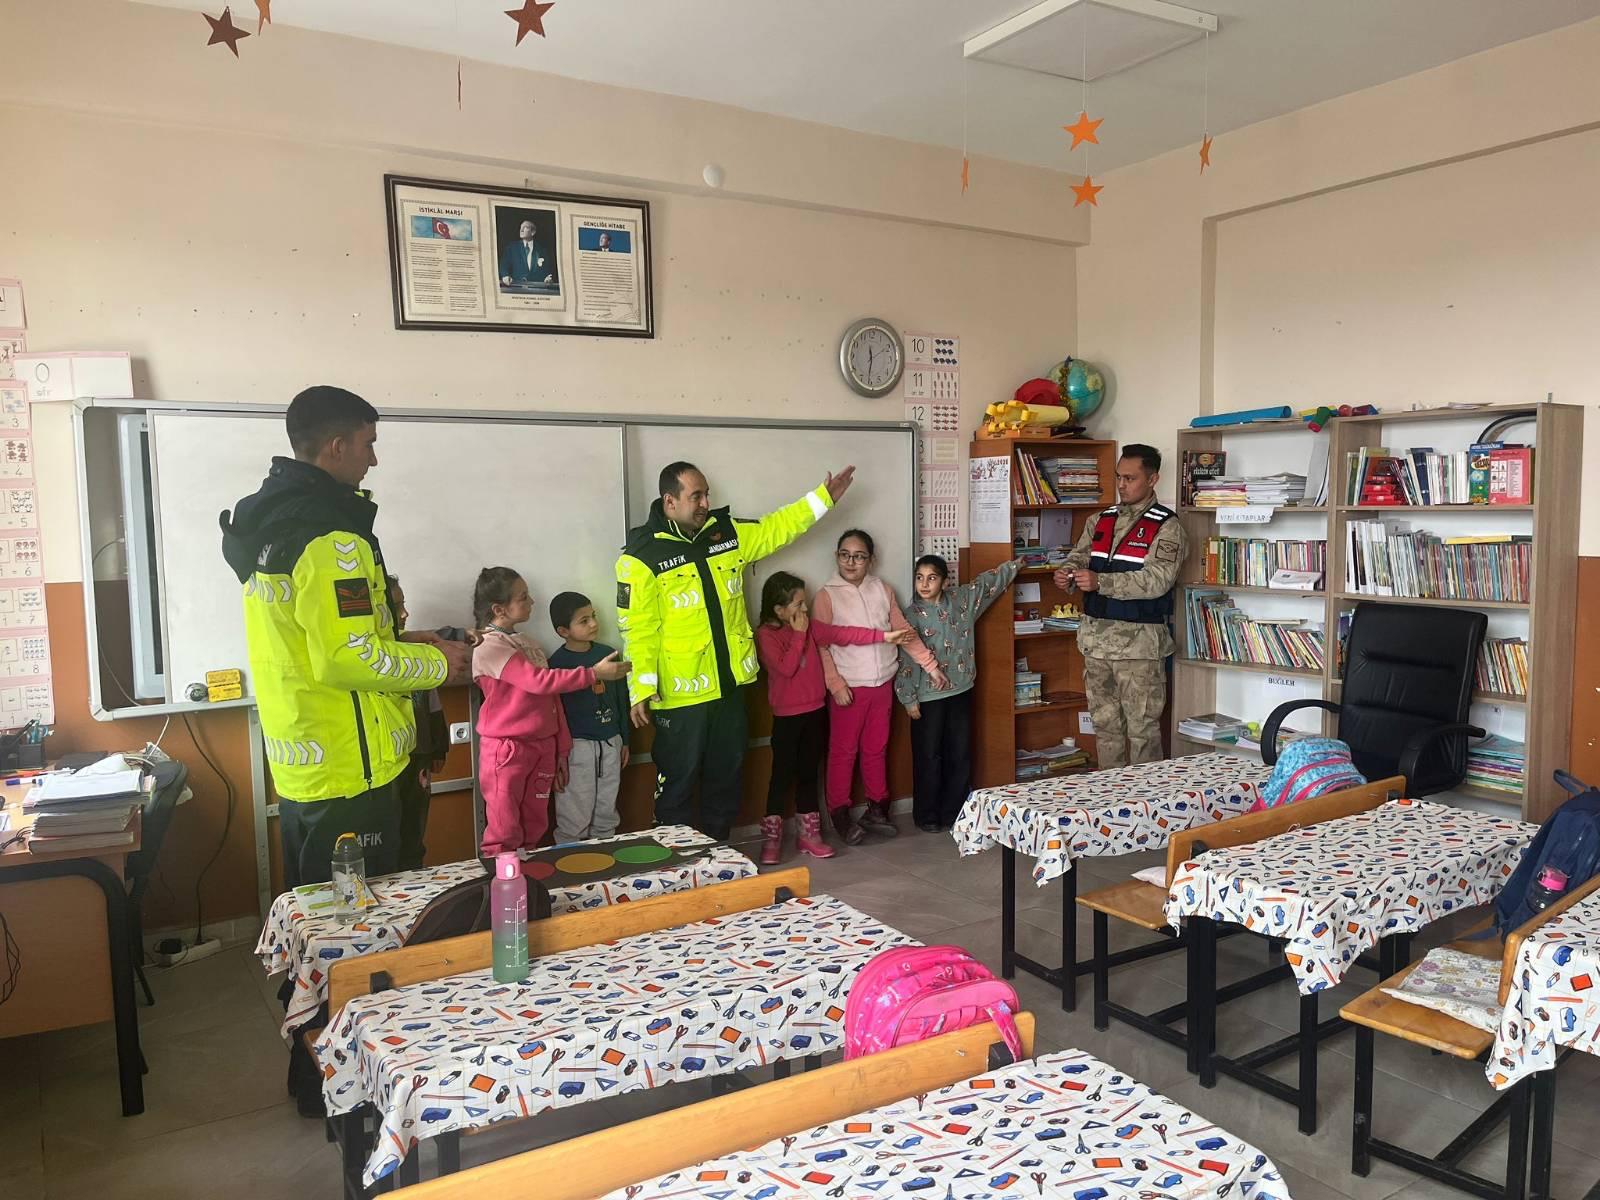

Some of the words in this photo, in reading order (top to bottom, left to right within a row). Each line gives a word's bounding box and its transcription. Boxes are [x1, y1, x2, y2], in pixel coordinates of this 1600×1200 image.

[868, 330, 876, 340] 12
[885, 343, 891, 353] 2
[911, 338, 925, 354] 10
[9, 367, 16, 378] 2
[35, 362, 50, 384] 0
[913, 372, 924, 388] 11
[911, 406, 925, 421] 12
[12, 417, 20, 428] 3
[20, 517, 28, 528] 5
[657, 554, 687, 571] TRAFİK
[24, 566, 32, 577] 6
[28, 615, 36, 625] 7
[32, 664, 40, 674] 8
[357, 831, 383, 848] AFİK
